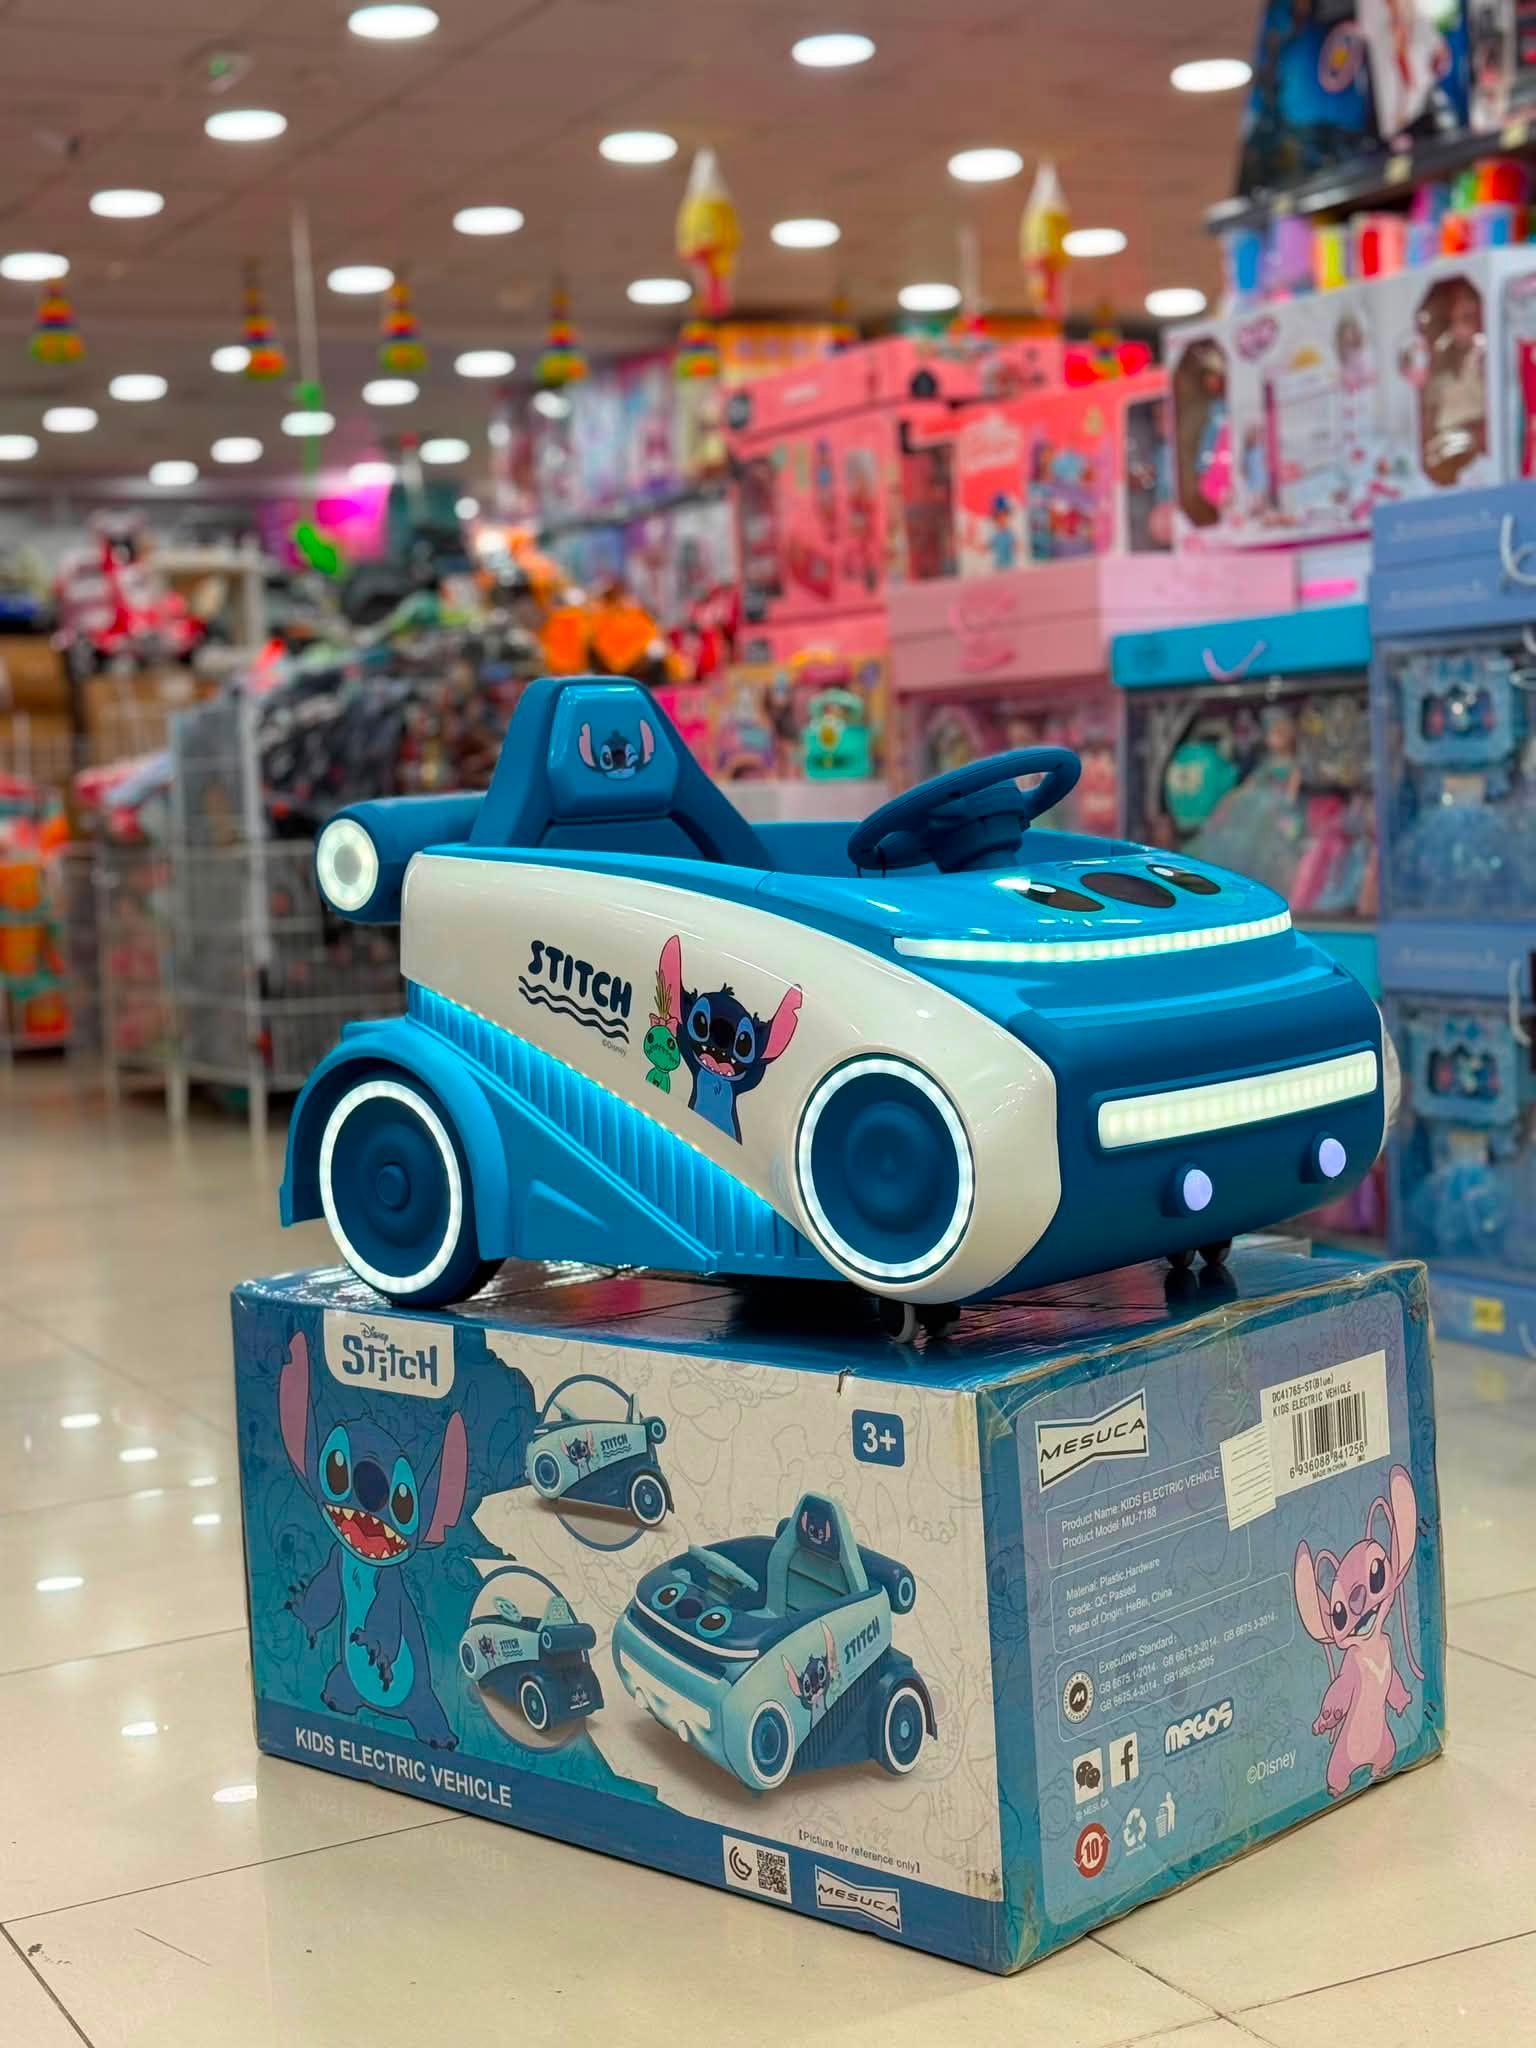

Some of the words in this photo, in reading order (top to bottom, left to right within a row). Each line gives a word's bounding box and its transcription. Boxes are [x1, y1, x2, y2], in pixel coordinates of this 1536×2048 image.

[528, 940, 632, 1018] STITCH
[360, 1322, 389, 1345] Disney
[1272, 1402, 1290, 1417] KIDS
[1292, 1391, 1323, 1411] ELECTRIC
[1325, 1380, 1352, 1399] VEHICLE
[600, 1433, 629, 1451] STITCH
[862, 1421, 897, 1453] 3+
[1040, 1418, 1145, 1463] MESUCA
[1061, 1511, 1093, 1534] Product
[1094, 1504, 1120, 1521] Name:
[1120, 1494, 1141, 1512] KIDS
[1142, 1479, 1184, 1505] ELECTRIC
[1184, 1465, 1221, 1489] VEHICLE
[1062, 1528, 1094, 1551] Product
[1121, 1505, 1157, 1528] MU-7188
[1109, 1584, 1136, 1602] Passed
[1068, 1620, 1090, 1637] Place
[1091, 1615, 1099, 1626] of
[1151, 1587, 1173, 1602] China
[844, 1615, 881, 1664] STITCH
[1099, 1681, 1111, 1694] GB
[1162, 1654, 1174, 1668] GB
[1223, 1629, 1235, 1641] GB
[1099, 1650, 1137, 1674] Executive
[1100, 1699, 1112, 1712] GB
[295, 1726, 336, 1757] KIDS
[339, 1739, 426, 1783] ELECTRIC
[430, 1764, 513, 1808] VEHICLE
[1247, 1749, 1297, 1784] ©Disney
[836, 1841, 848, 1853] for
[851, 1847, 894, 1866] reference
[1085, 1837, 1100, 1864] 10
[818, 1882, 899, 1915] MESUCA
